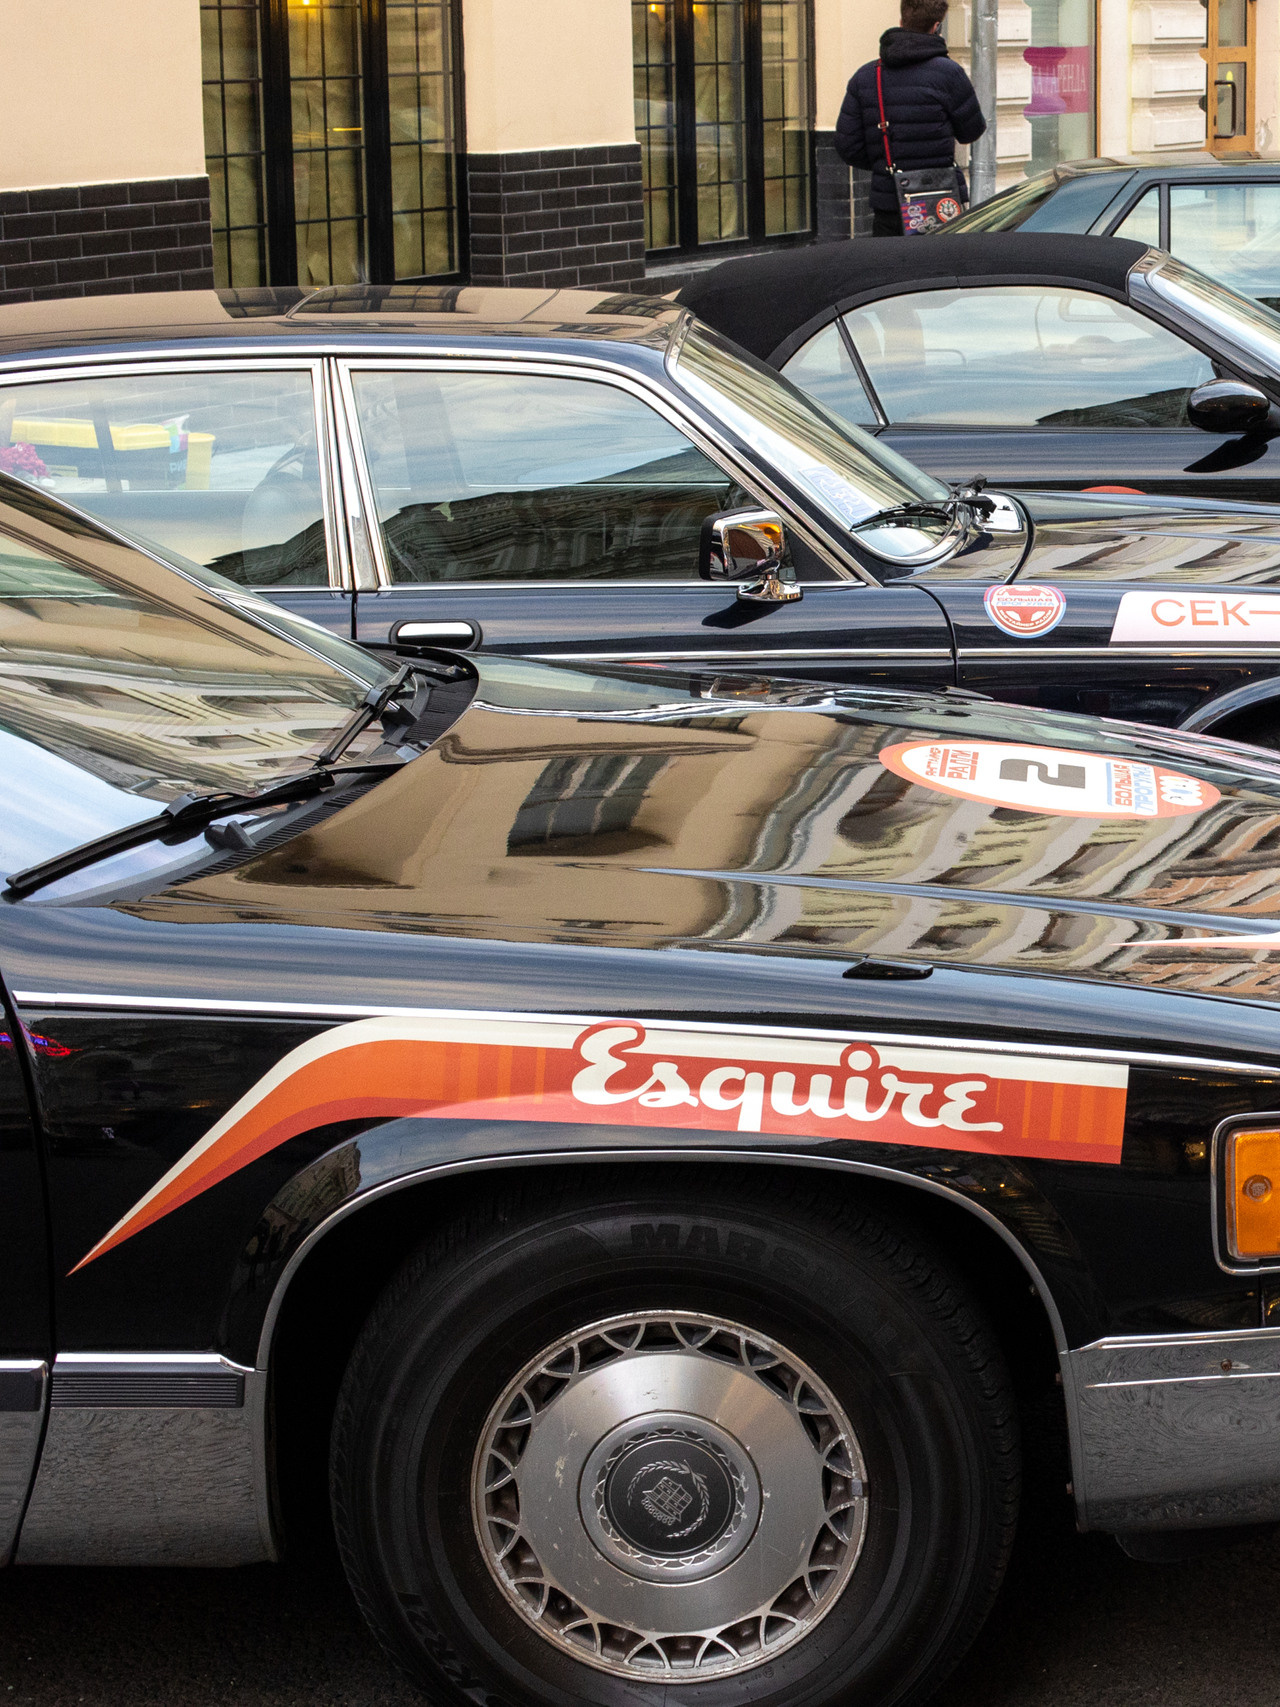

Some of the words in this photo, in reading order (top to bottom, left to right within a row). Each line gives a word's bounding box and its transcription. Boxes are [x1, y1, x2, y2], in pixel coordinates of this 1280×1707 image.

[947, 749, 973, 780] РАЛЛИ
[999, 758, 1086, 789] 2
[1113, 764, 1132, 806] БОЛЬШАЯ
[571, 1026, 1004, 1132] Esquire
